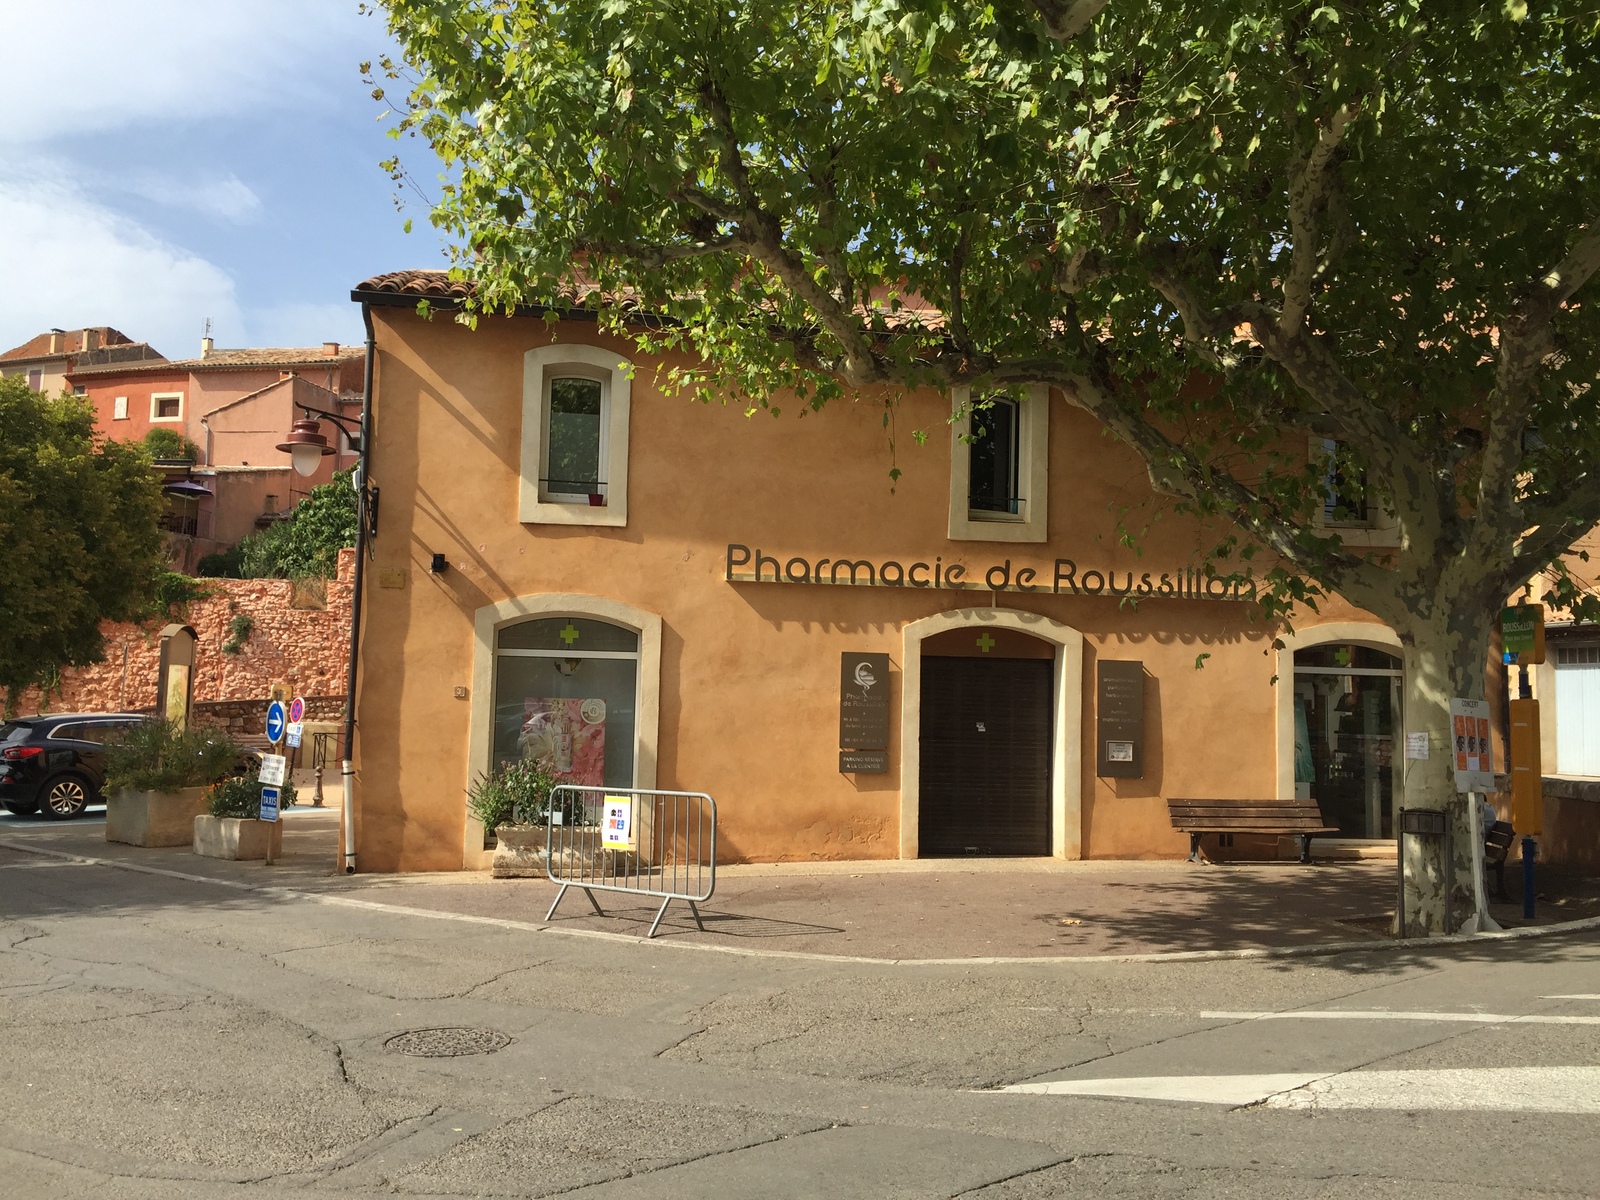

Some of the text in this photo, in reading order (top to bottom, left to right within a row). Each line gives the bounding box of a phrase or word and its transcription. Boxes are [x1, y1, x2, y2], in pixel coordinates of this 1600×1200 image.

[726, 544, 1257, 601] Pharmacie de Roussillon
